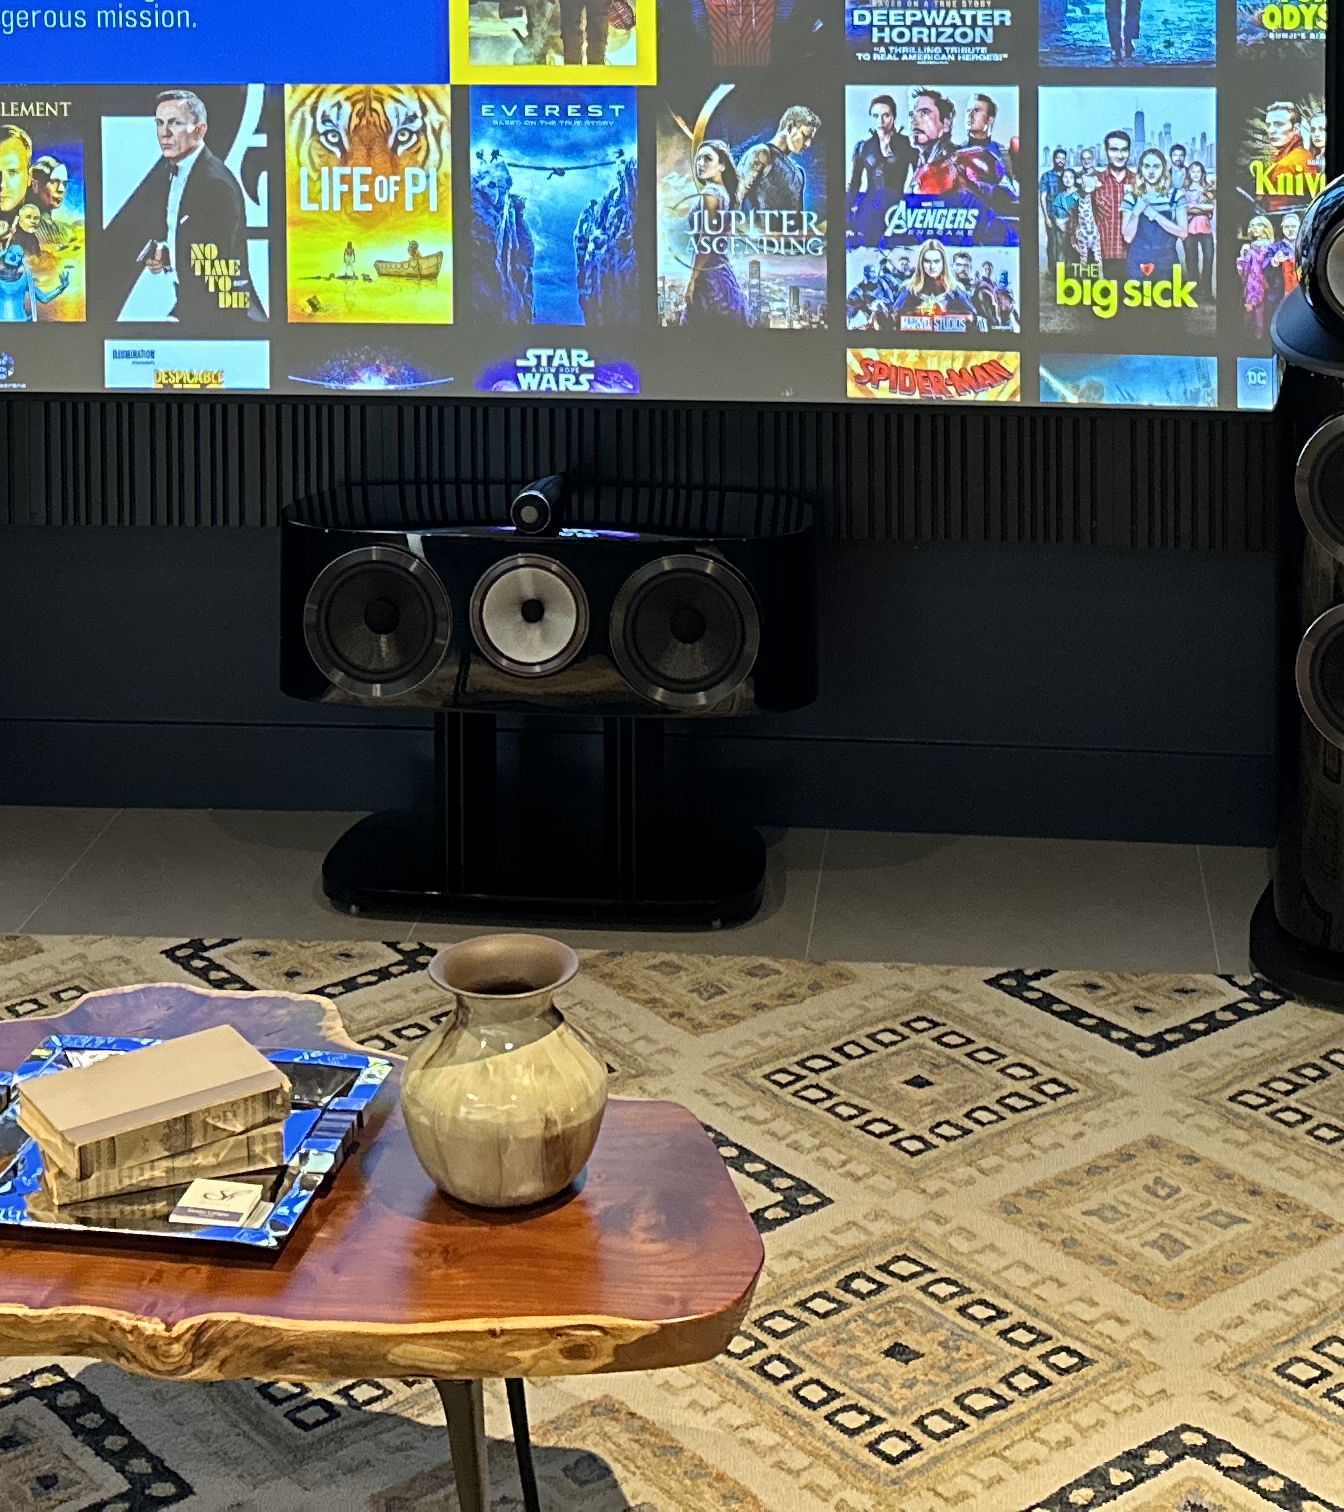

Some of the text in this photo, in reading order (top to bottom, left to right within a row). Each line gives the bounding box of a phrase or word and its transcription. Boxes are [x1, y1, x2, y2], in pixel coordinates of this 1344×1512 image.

[97, 3, 197, 29] mission.
[852, 9, 1012, 26] DEEPWATER
[871, 26, 994, 43] HORIZON
[481, 104, 625, 117] EVEREST
[1249, 160, 1326, 199] Kniv
[300, 166, 438, 211] LIFE OF PI
[685, 209, 827, 237] JUPITER
[884, 199, 979, 237] AVENGERS
[191, 243, 218, 260] NO
[686, 236, 825, 256] ASCENDING
[190, 259, 241, 276] TIME
[1071, 262, 1099, 278] THE
[204, 275, 232, 292] TO
[1056, 261, 1199, 319] big sick
[218, 291, 250, 308] DIE
[516, 348, 595, 367] STAR
[154, 369, 225, 385] DESPICABLE
[517, 373, 594, 391] WARS
[854, 357, 1015, 400] SPIDER-MAN
[1247, 371, 1266, 385] DC
